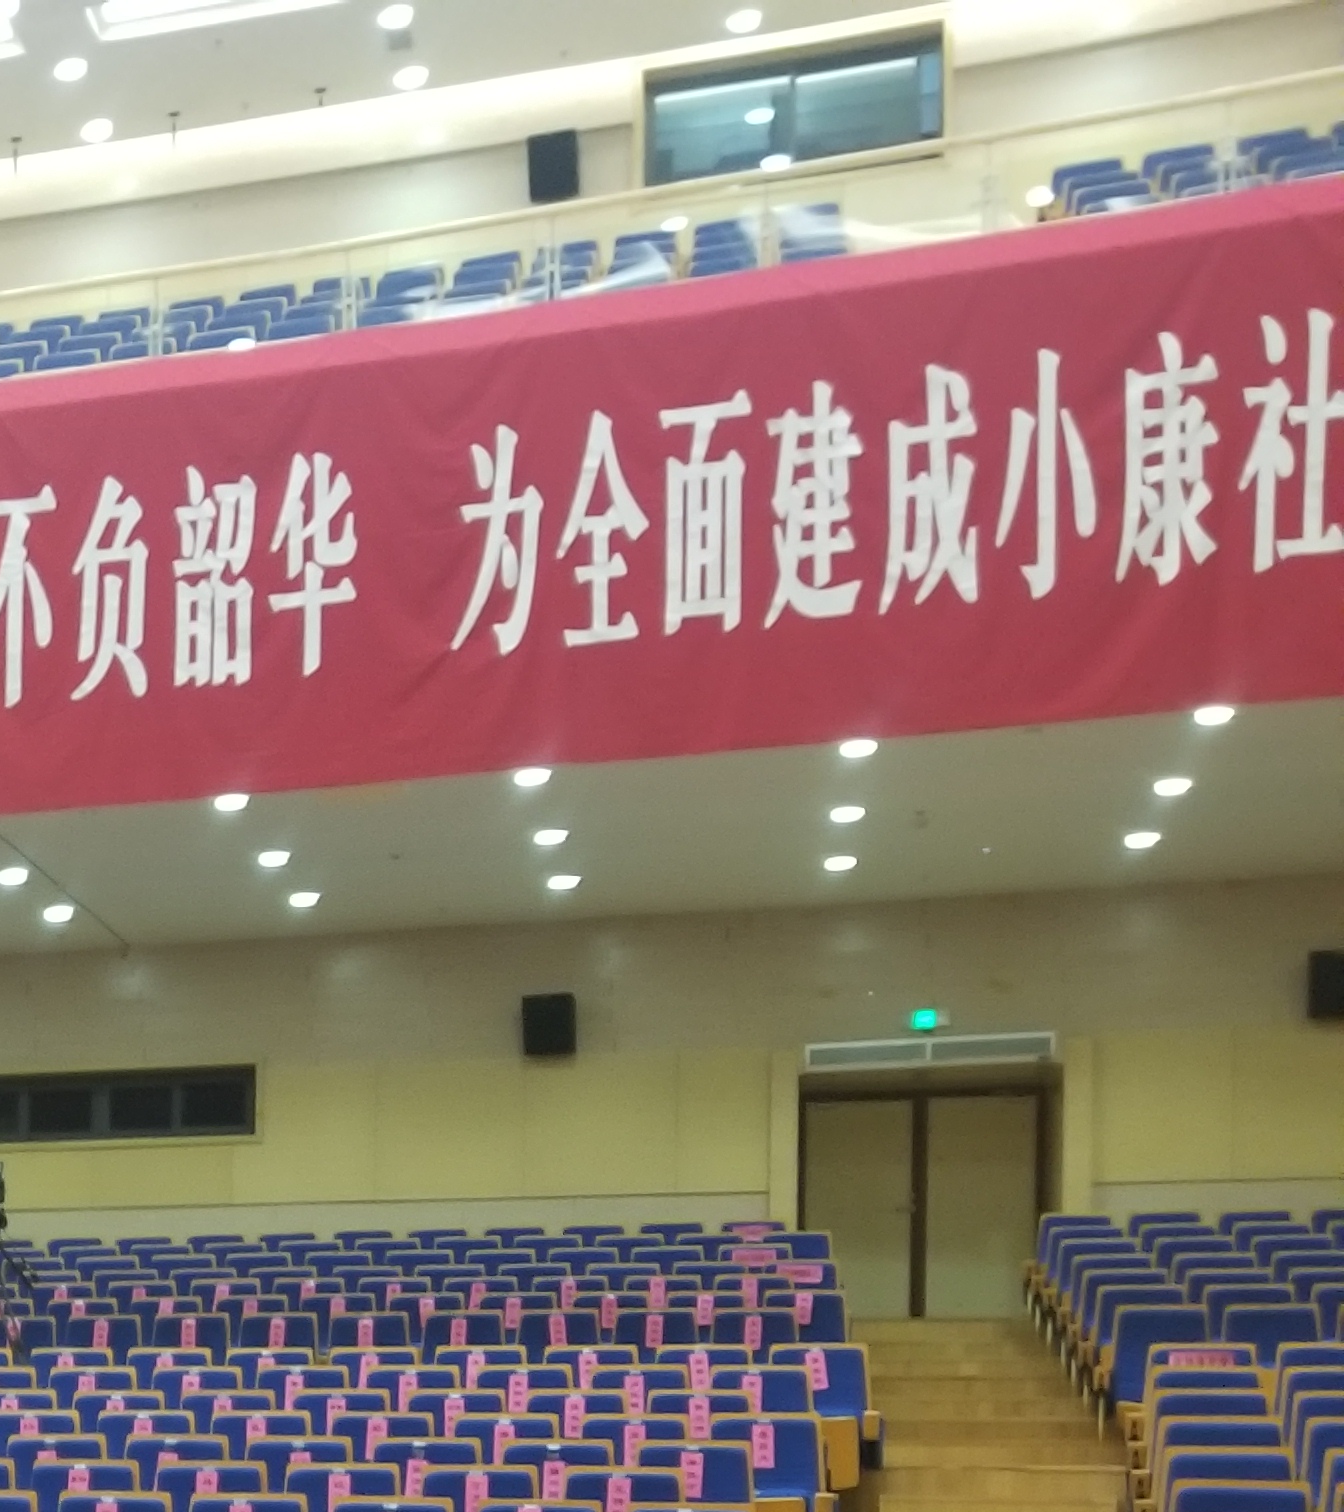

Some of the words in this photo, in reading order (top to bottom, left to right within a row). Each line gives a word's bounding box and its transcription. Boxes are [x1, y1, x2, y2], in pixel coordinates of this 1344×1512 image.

[450, 308, 1344, 656] 为全面建成小康社
